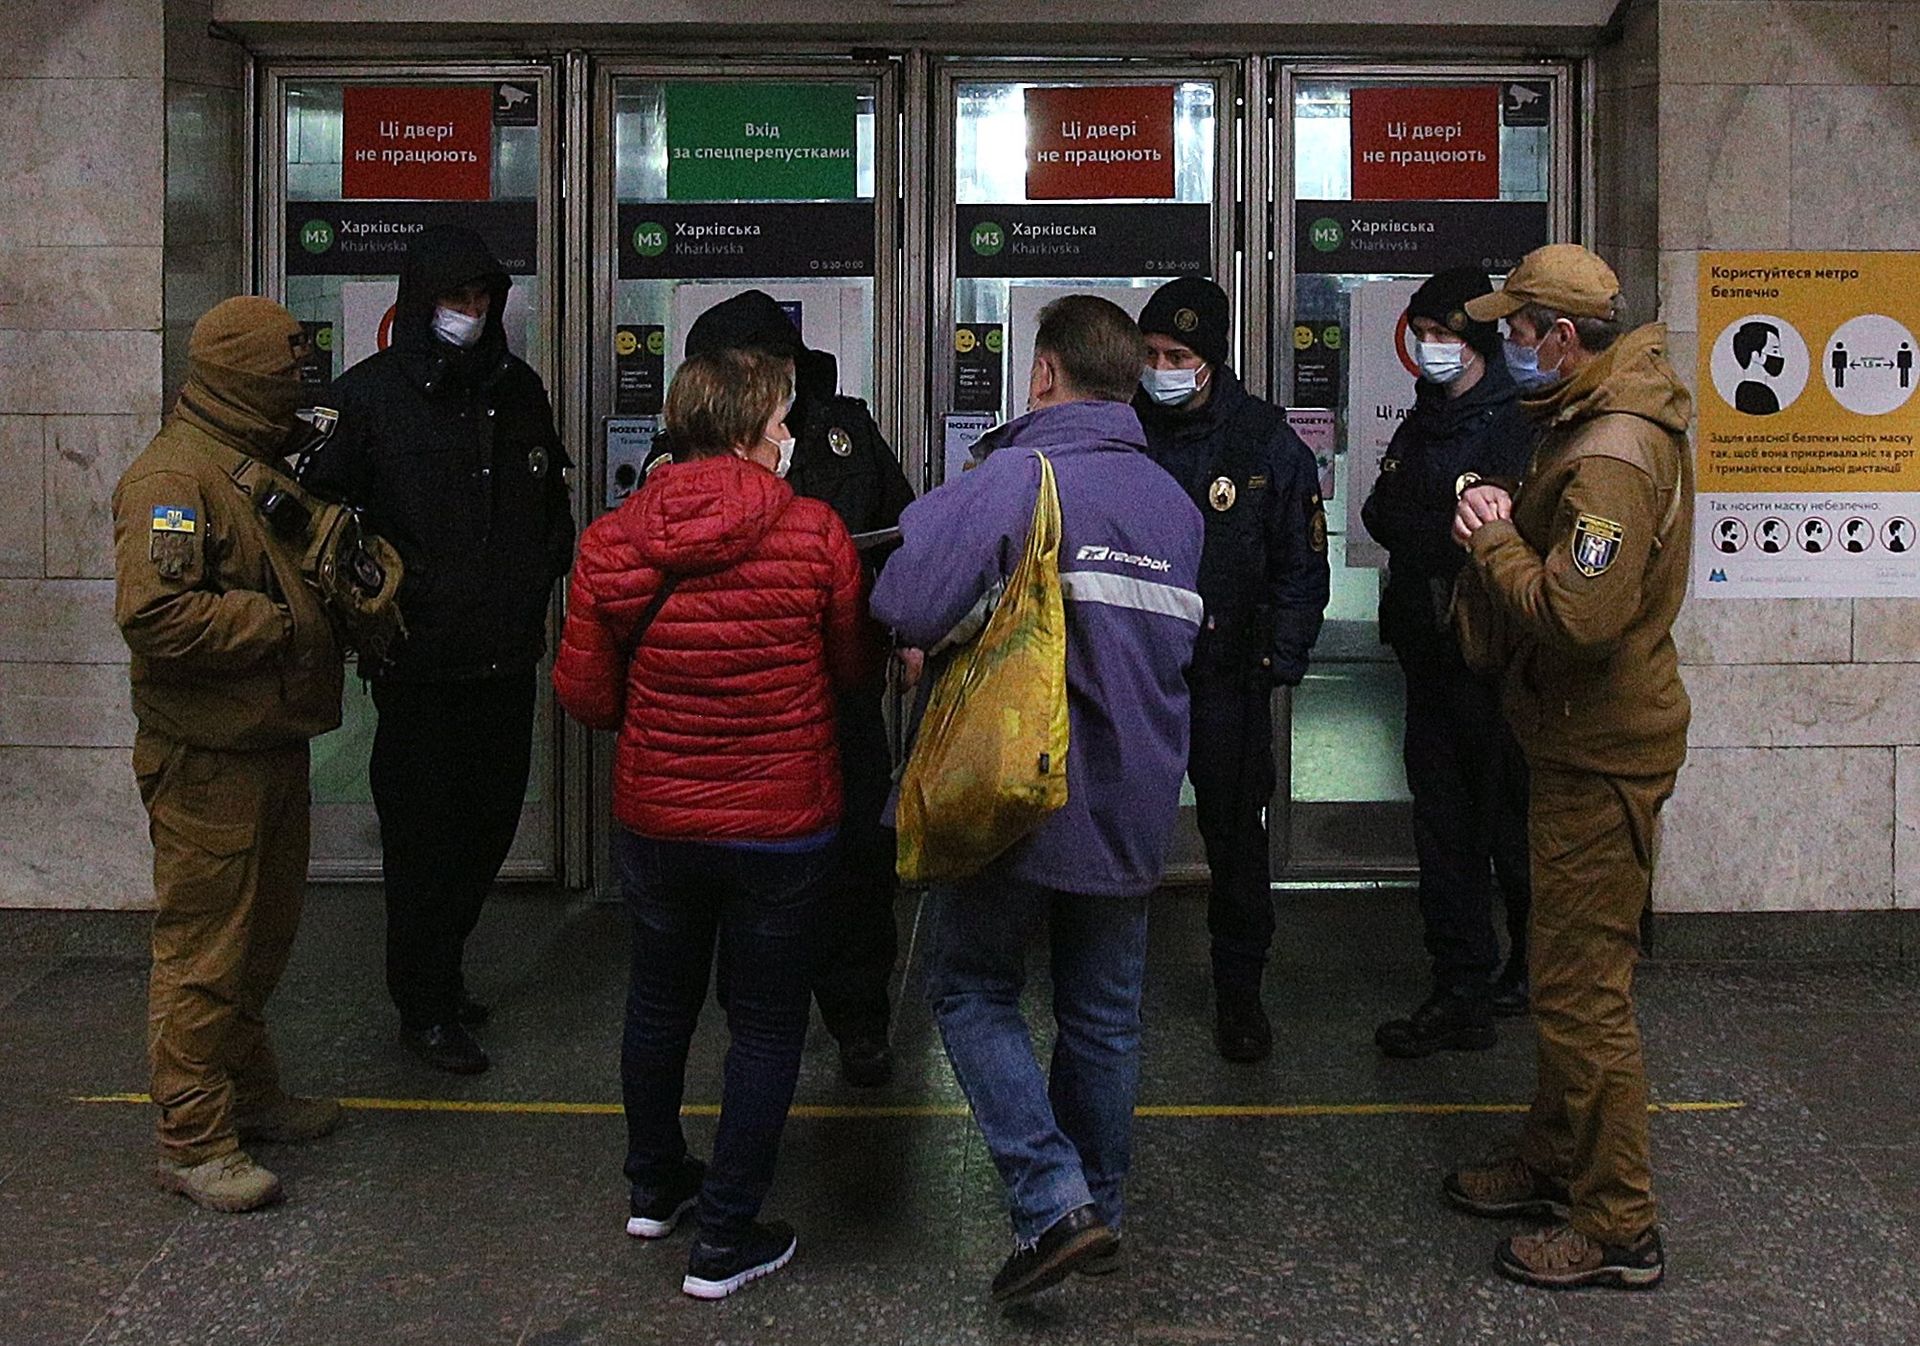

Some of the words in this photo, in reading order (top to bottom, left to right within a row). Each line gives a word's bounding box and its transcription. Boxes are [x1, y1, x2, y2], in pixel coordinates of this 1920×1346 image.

[380, 121, 399, 139] Ці
[404, 121, 454, 141] двері
[745, 123, 780, 139] Вхід
[1061, 121, 1081, 140] Ці
[1087, 121, 1137, 141] двері
[1387, 122, 1407, 140] Ці
[1412, 121, 1462, 142] двері
[355, 150, 377, 162] не
[382, 149, 478, 166] працюють
[673, 147, 690, 159] за
[695, 147, 851, 162] спецперепустками
[1037, 151, 1060, 163] не
[1065, 150, 1162, 166] працюють
[1363, 151, 1385, 163] не
[1390, 150, 1487, 166] працюють
[340, 220, 424, 236] Харківська
[675, 222, 761, 238] Харківська
[1012, 222, 1097, 238] Харківська
[1351, 220, 1435, 236] Харківська
[340, 240, 408, 252] Kharkivska
[675, 242, 744, 255] Kharkivska
[1012, 242, 1080, 255] Kharkivska
[1351, 238, 1418, 251] Kharkivska
[1711, 266, 1811, 283] Користуйтеся
[1815, 268, 1859, 283] метро
[1711, 284, 1779, 298] безпечно
[1376, 405, 1392, 420] Ці
[948, 422, 995, 430] ROZETKA
[1710, 433, 1744, 443] Задля
[1746, 433, 1789, 443] власної
[1792, 433, 1839, 443] безпеки
[1841, 434, 1877, 443] носіть
[1880, 435, 1913, 445] маску
[1734, 448, 1758, 459] щоб
[1761, 450, 1788, 458] вона
[1791, 450, 1858, 460] прикривала
[1861, 448, 1877, 458] ніс
[1880, 450, 1892, 458] та
[1894, 450, 1915, 460] рот
[1715, 464, 1781, 475] тримайтеся
[1784, 463, 1845, 474] соціальної
[1847, 462, 1901, 474] дистанції
[1710, 501, 1727, 511] Так
[1731, 502, 1771, 511] носити
[1774, 502, 1808, 513] маску
